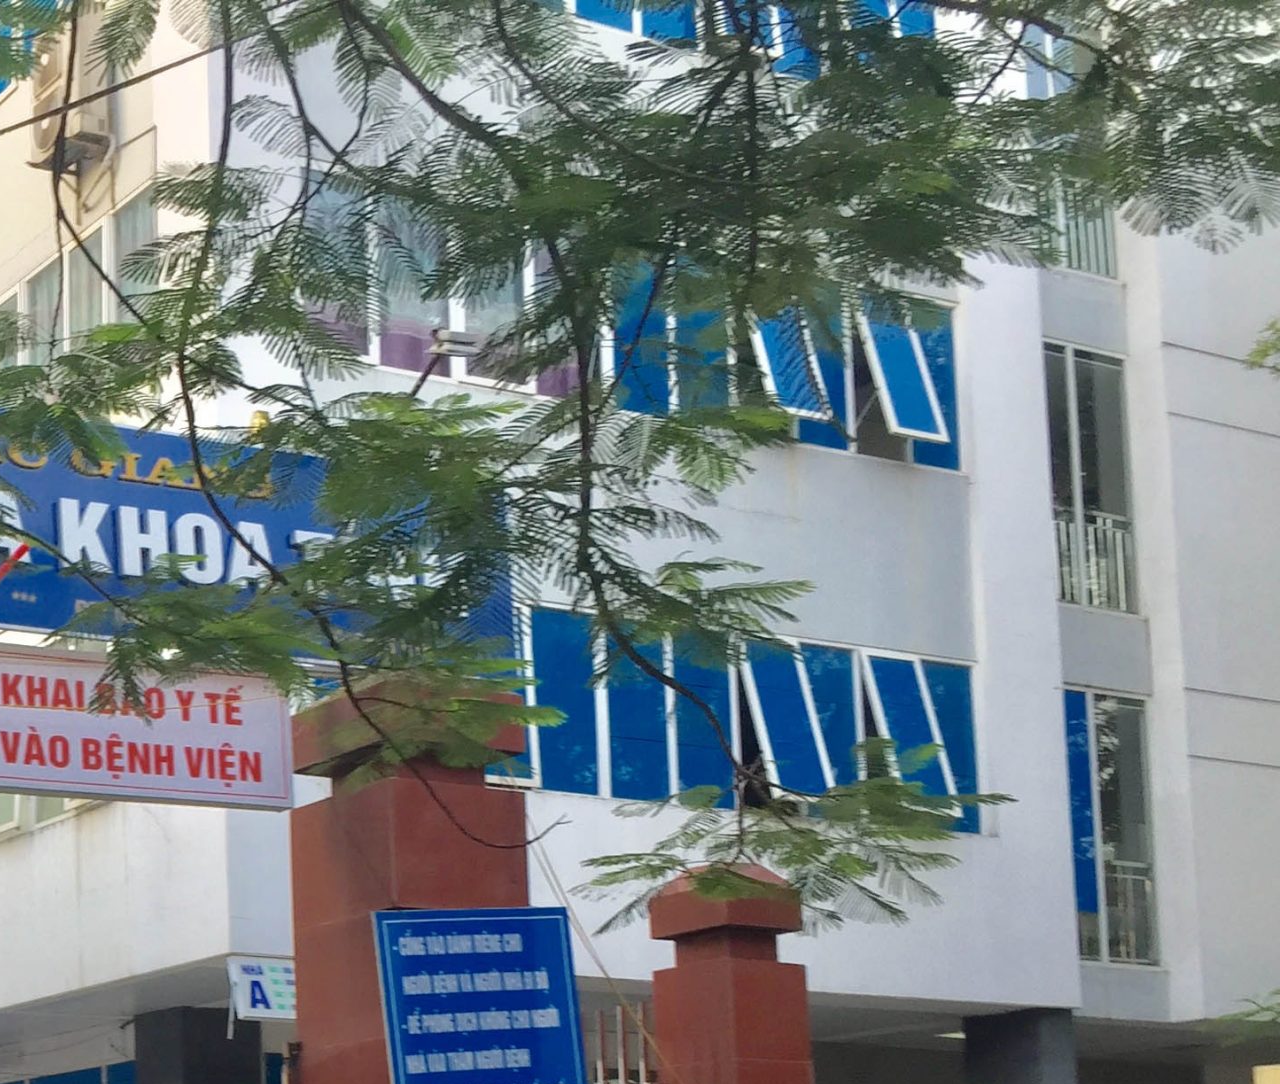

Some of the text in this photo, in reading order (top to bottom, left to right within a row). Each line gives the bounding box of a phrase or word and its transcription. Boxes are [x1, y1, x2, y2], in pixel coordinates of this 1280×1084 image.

[71, 440, 273, 500] GIA
[58, 497, 275, 591] KHOA
[1, 672, 87, 713] KHAI
[175, 689, 195, 722] Y
[204, 685, 244, 727] TẾ
[0, 725, 71, 769] VÀO
[81, 733, 175, 781] BỆNH
[184, 742, 262, 787] VIỆN
[250, 980, 272, 1010] A
